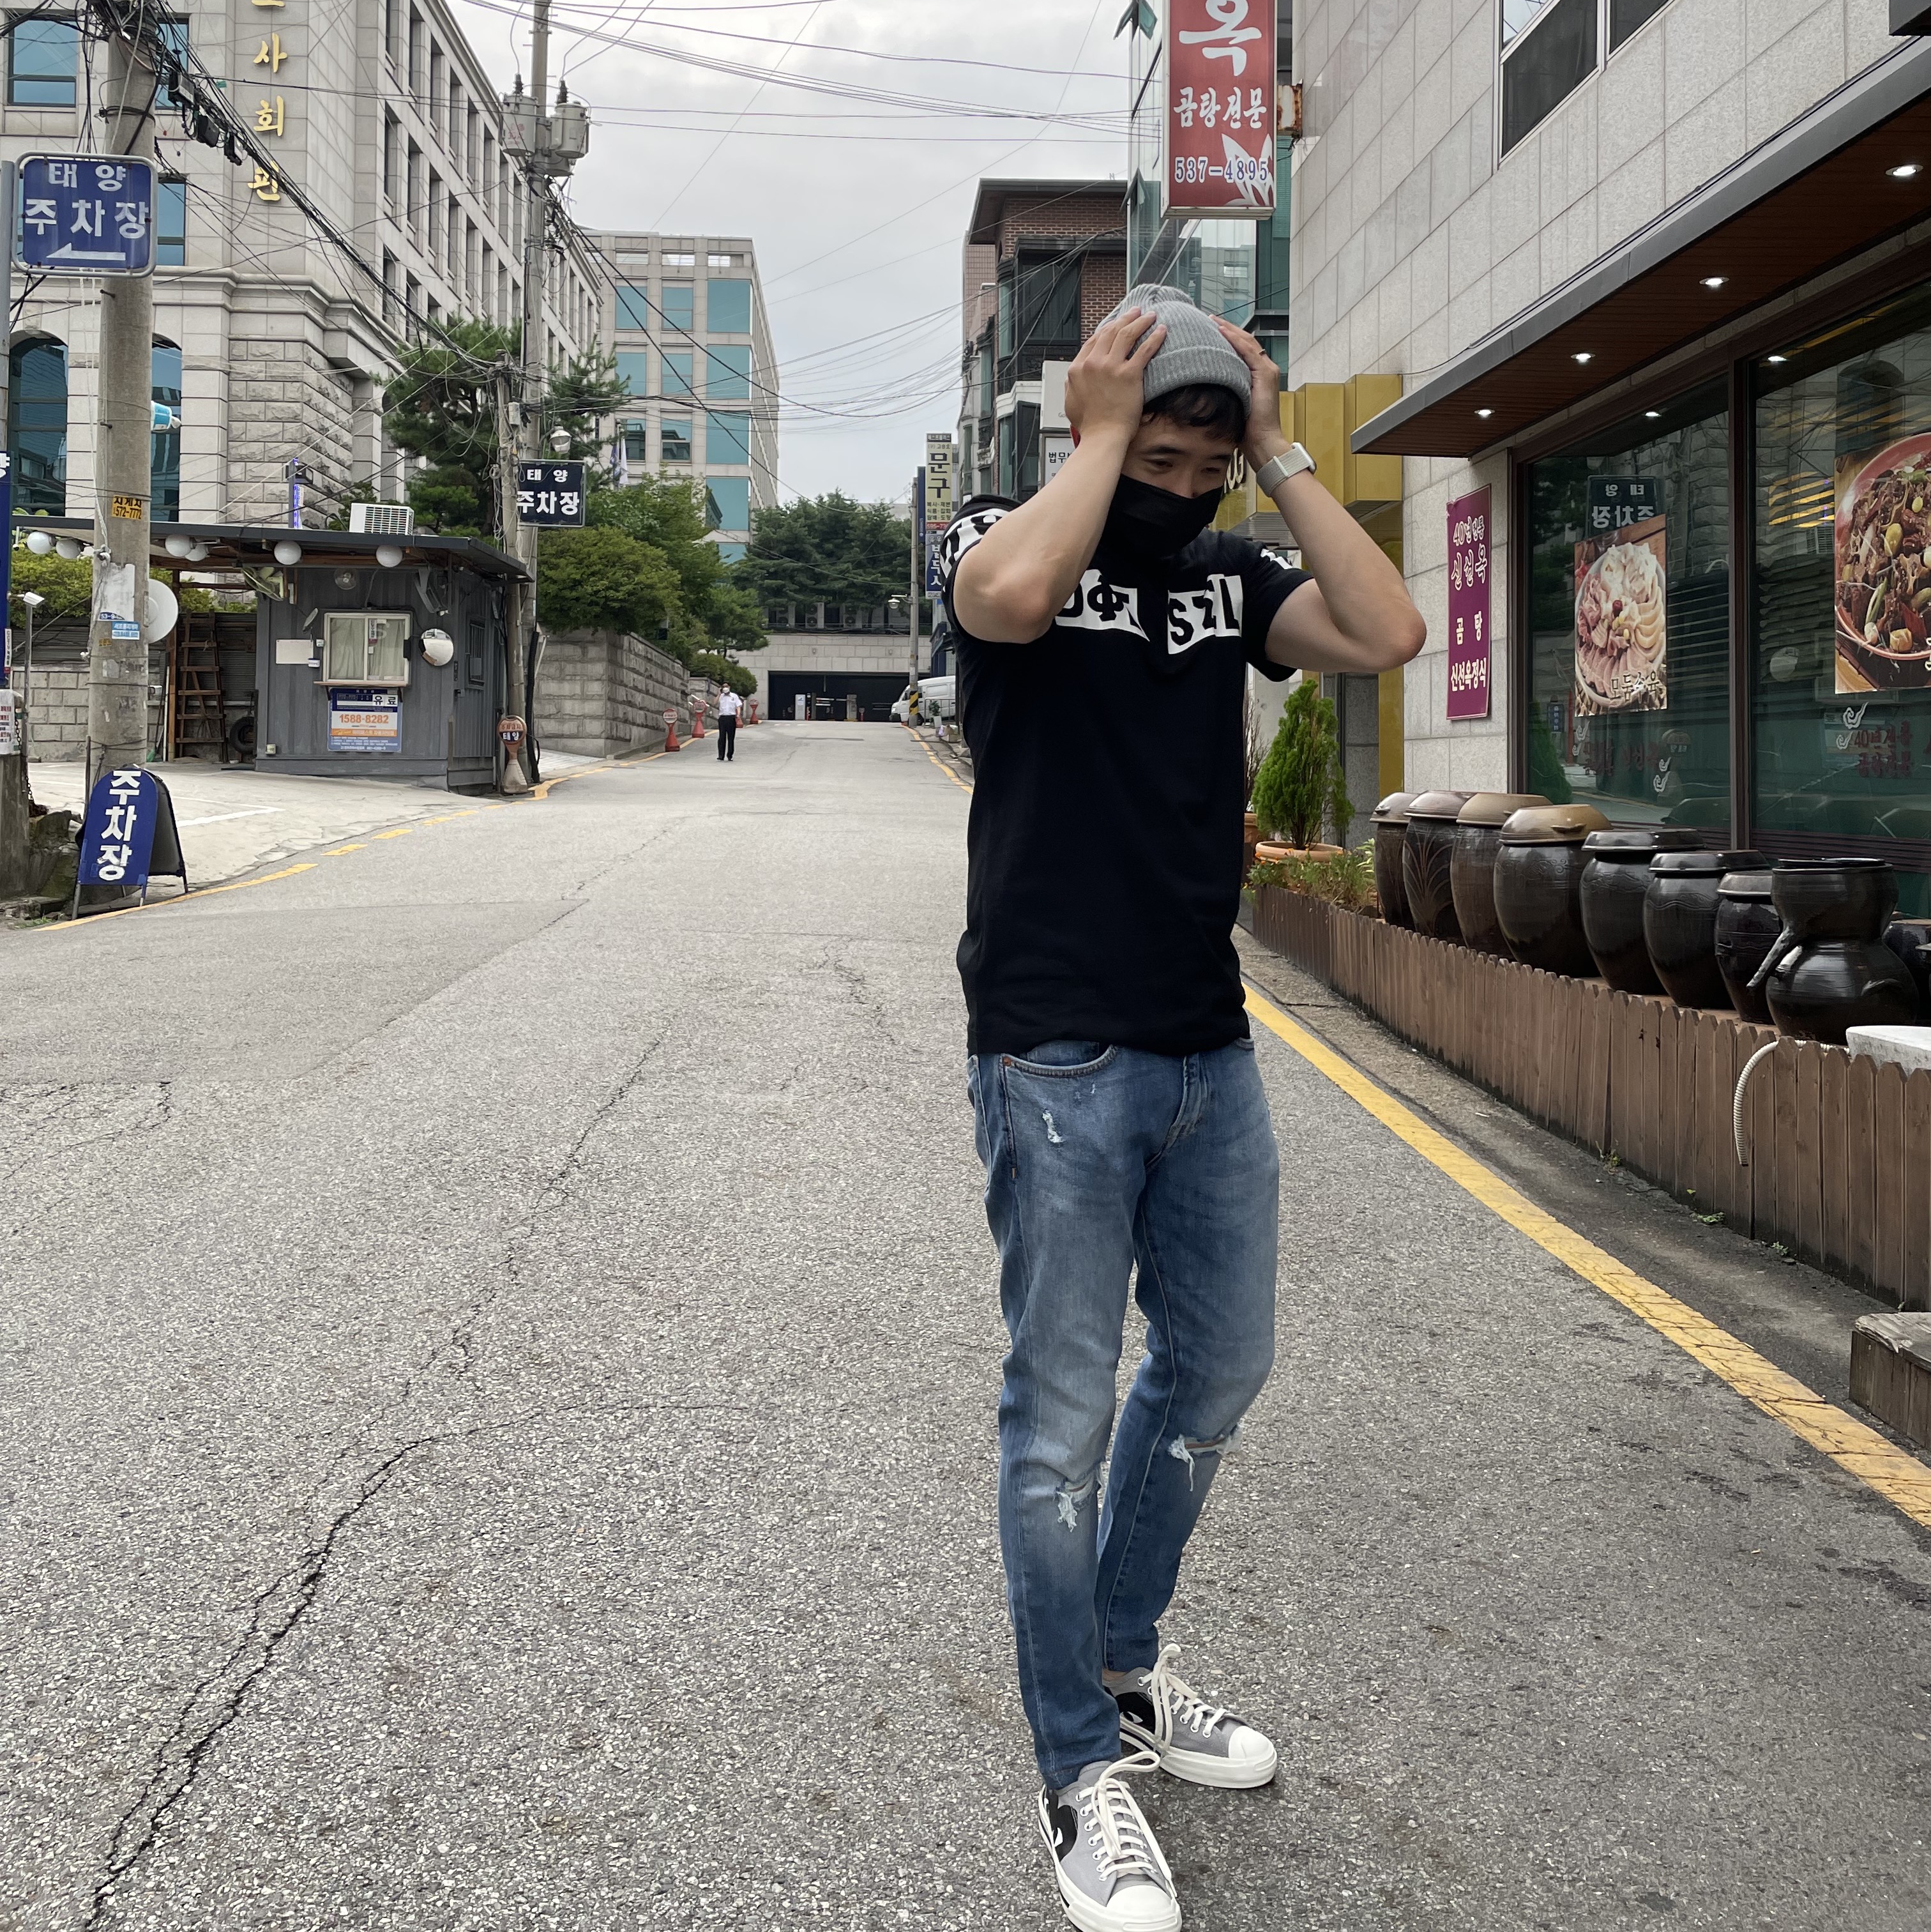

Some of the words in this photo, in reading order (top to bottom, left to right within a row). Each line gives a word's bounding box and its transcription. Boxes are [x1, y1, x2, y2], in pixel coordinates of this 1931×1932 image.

[248, 0, 287, 201] 사회관
[1173, 86, 1267, 129] 곰탕전문
[49, 163, 126, 192] 태양
[1175, 156, 1269, 183] 537-4895
[25, 199, 149, 239] 주차장
[527, 469, 568, 483] 태양
[928, 452, 950, 498] 문구
[516, 491, 580, 515] 주차장
[1451, 657, 1487, 692] 신선옥정식
[373, 695, 397, 706] 유료
[339, 713, 389, 724] 1588-8282
[503, 731, 519, 741] 태양
[96, 770, 142, 881] 주차장
